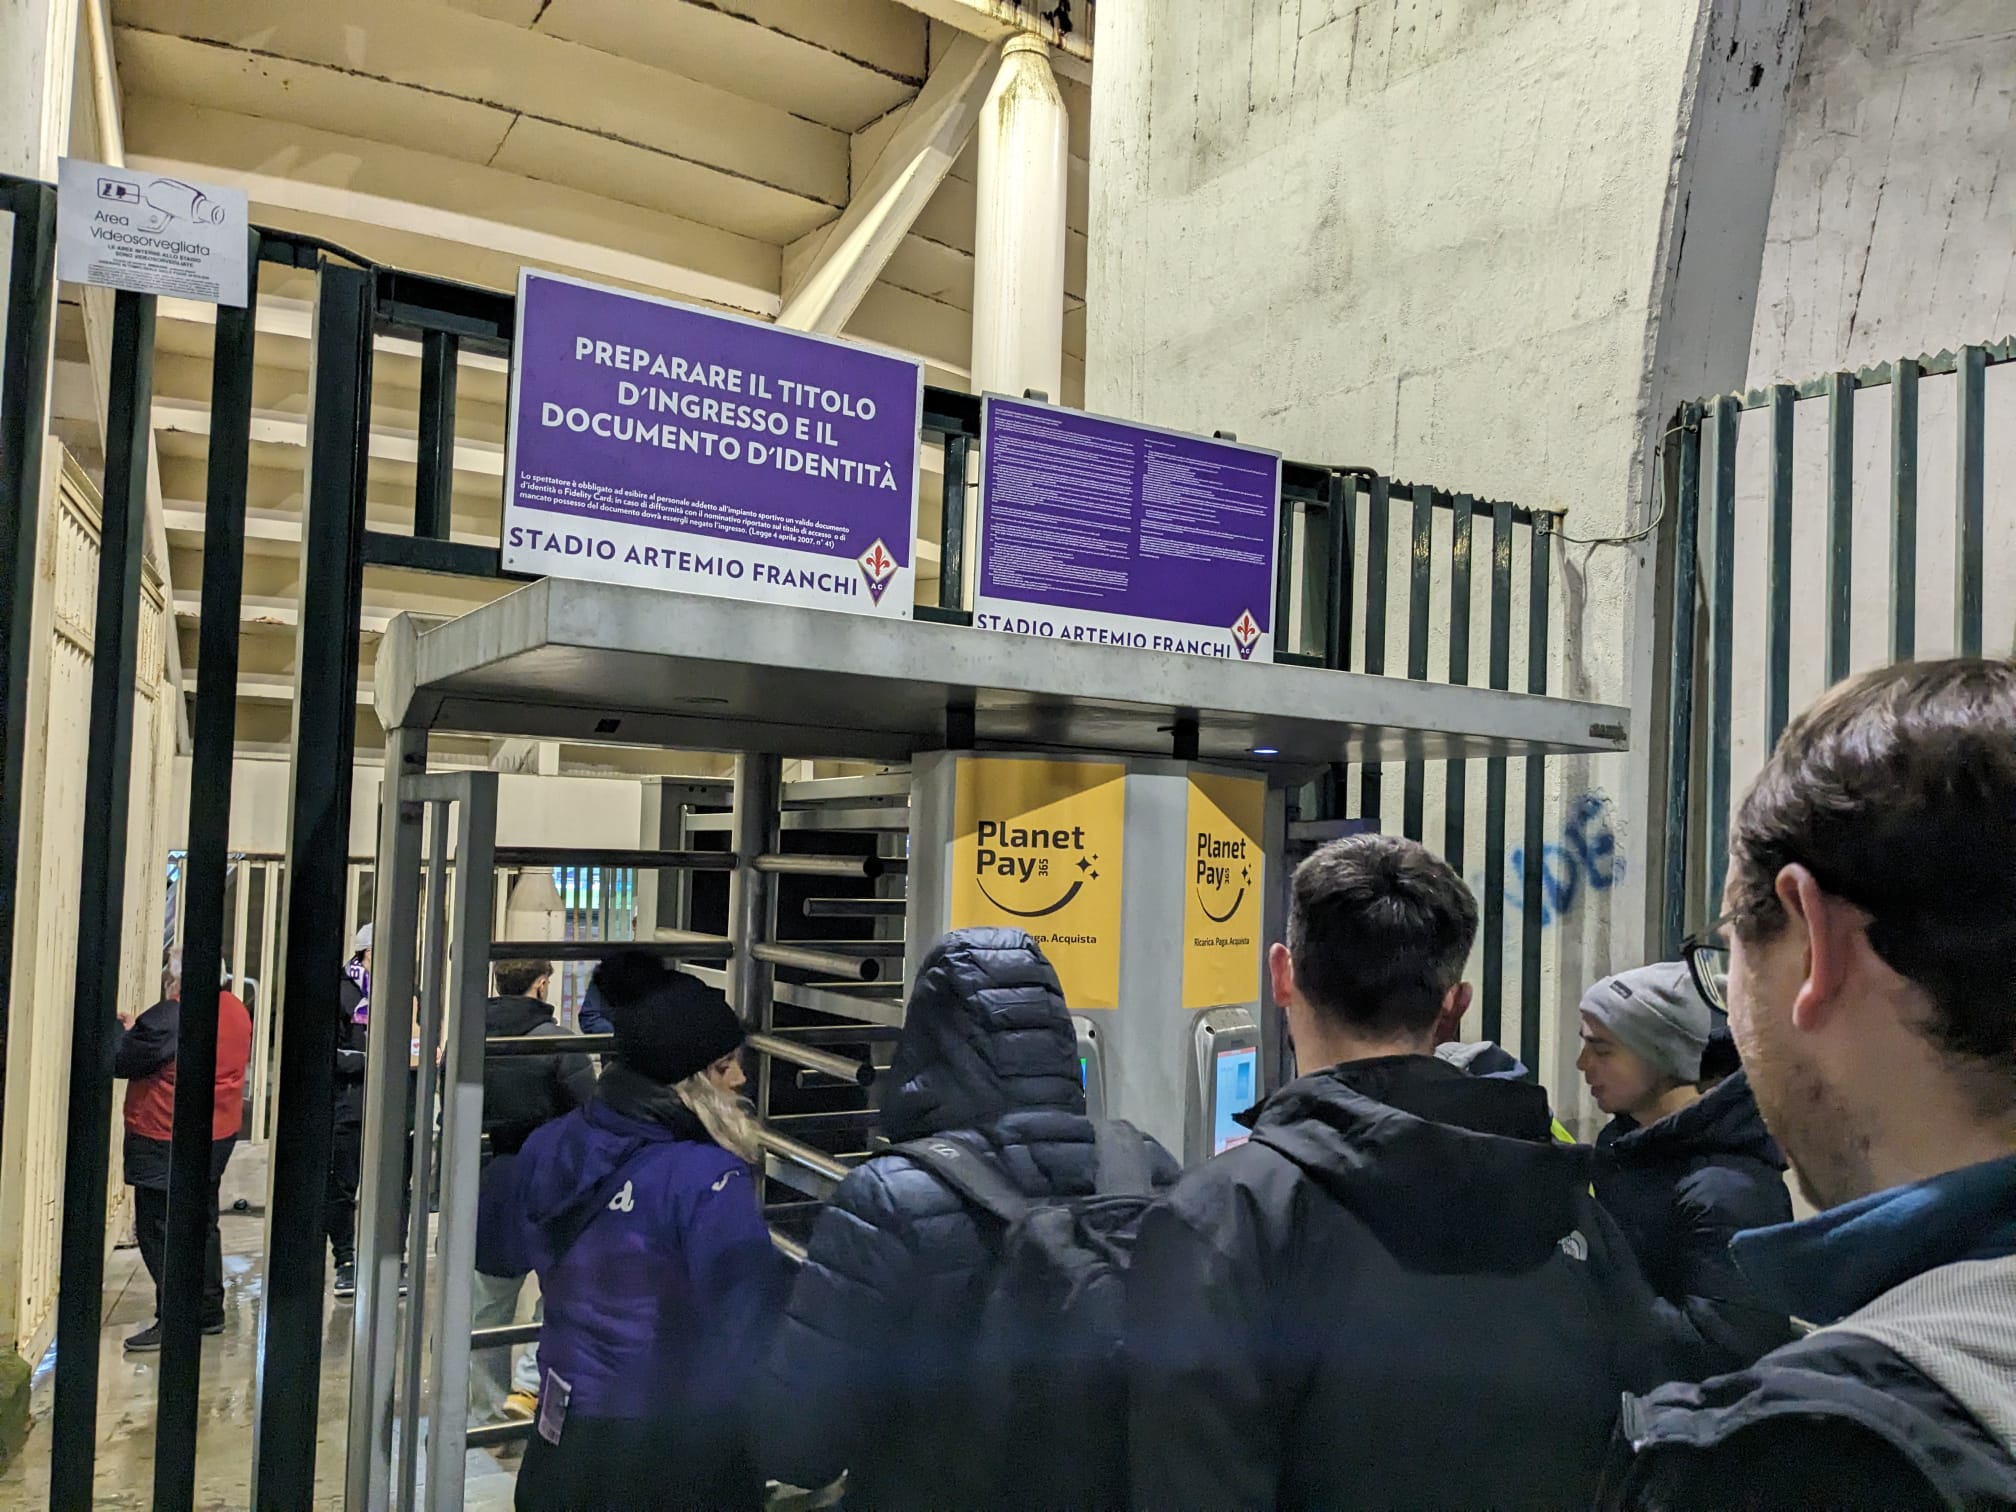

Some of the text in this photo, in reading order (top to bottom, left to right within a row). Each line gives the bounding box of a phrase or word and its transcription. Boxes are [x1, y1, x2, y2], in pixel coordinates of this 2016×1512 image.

[94, 210, 129, 226] Area
[90, 226, 211, 256] Videosorvegliata
[574, 336, 877, 421] PREPARARE IL TITOLO
[617, 381, 839, 447] D'INGRESSO E IL
[541, 402, 898, 491] DOCUMENTO D'IDENTITÀ
[520, 492, 552, 502] mancato
[553, 498, 586, 508] possesso
[587, 501, 598, 510] del
[599, 503, 640, 516] documento
[641, 510, 661, 520] dovrà
[662, 515, 689, 525] essergli
[689, 519, 713, 528] negato
[748, 527, 772, 539] (Legge
[778, 533, 796, 542] aprile
[521, 471, 531, 480] Lo
[532, 475, 571, 487] spettatore
[578, 481, 613, 494] obbligato
[624, 490, 648, 499] esibire
[656, 495, 689, 506] personale
[691, 501, 717, 511] addetto
[758, 512, 784, 522] sportivo
[795, 519, 814, 527] valido
[814, 521, 849, 533] documento
[564, 488, 592, 500] Fidelity
[623, 499, 639, 507] caso
[640, 500, 647, 508] di
[648, 502, 684, 514] difformità
[704, 513, 741, 524] nominativo
[742, 517, 771, 529] riportato
[783, 525, 800, 533] titolo
[801, 527, 807, 535] di
[808, 531, 832, 539] accesso
[509, 526, 857, 596] STADIO ARTEMIO FRANCHI
[977, 613, 1231, 658] STADIO ARTEMIO FRANCHI
[977, 820, 1085, 850] Planet
[1197, 832, 1246, 859] Planet
[976, 849, 1049, 883] Pay 365
[1197, 860, 1224, 891] Pay
[1051, 933, 1097, 945] Acquista
